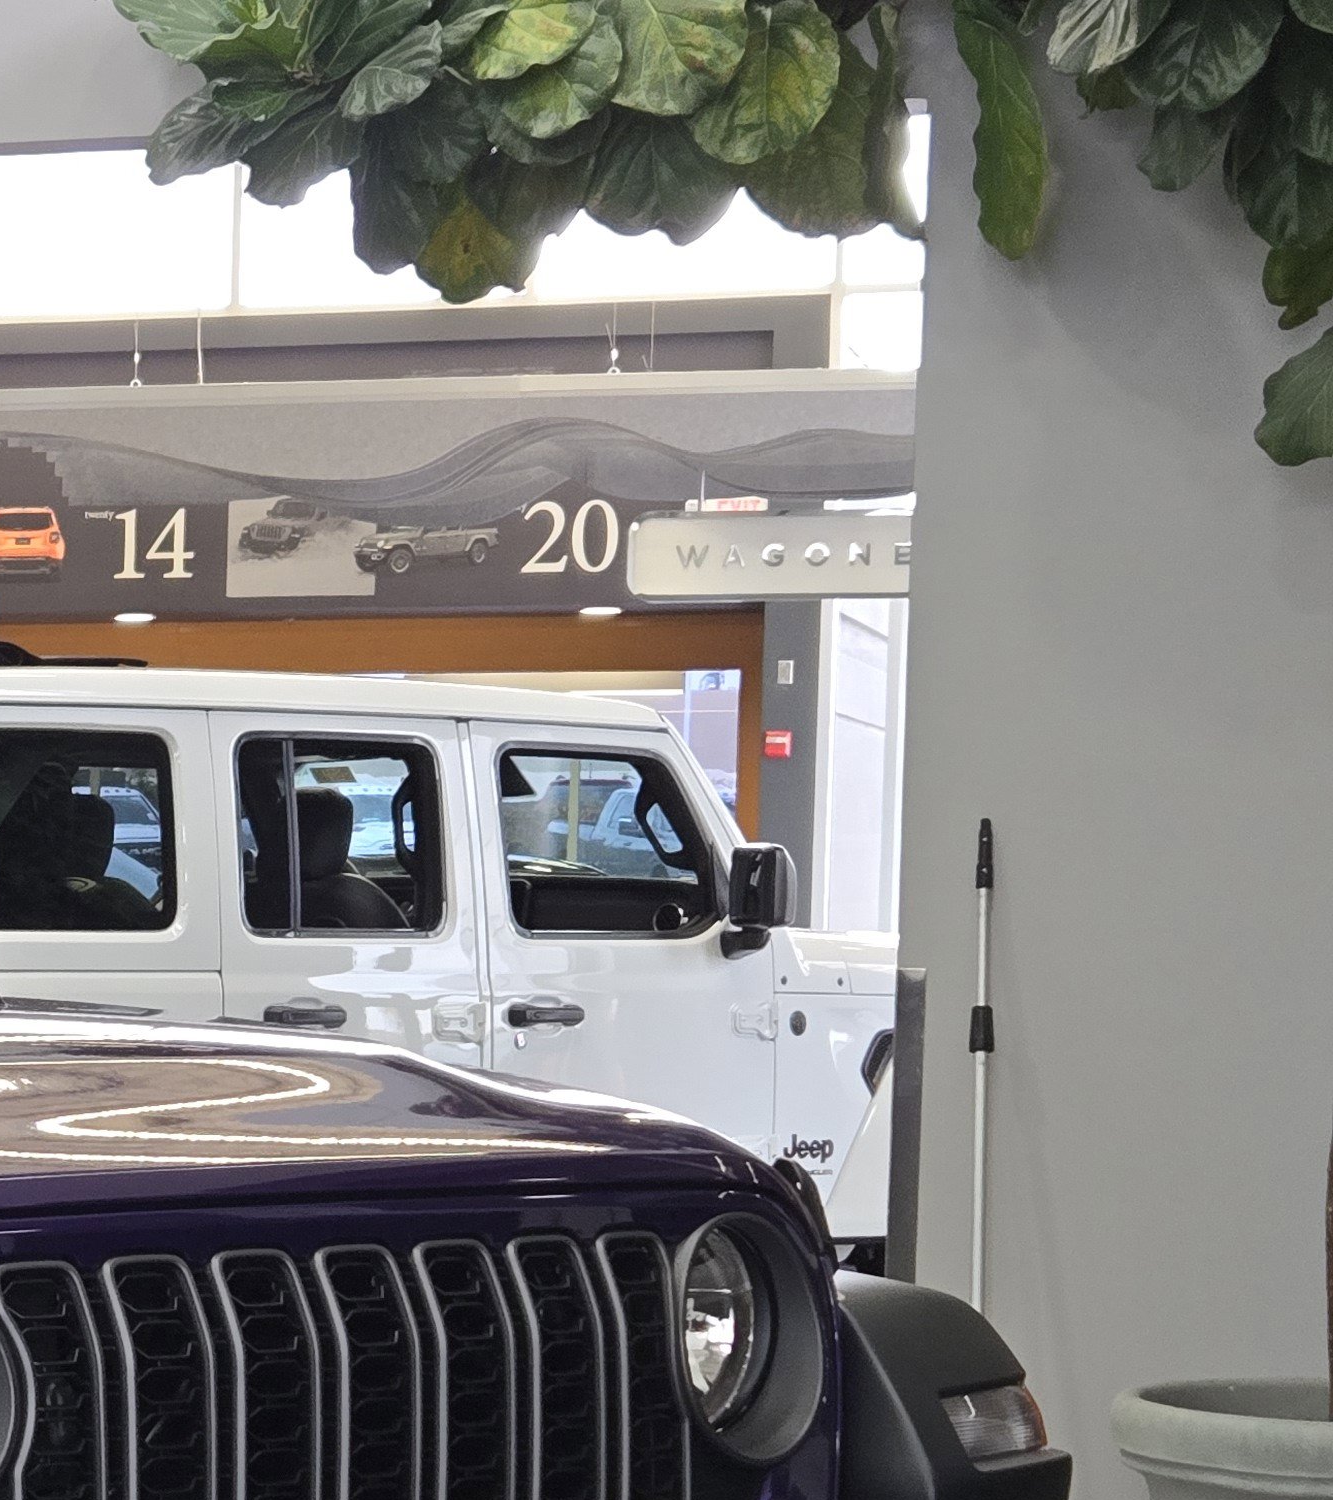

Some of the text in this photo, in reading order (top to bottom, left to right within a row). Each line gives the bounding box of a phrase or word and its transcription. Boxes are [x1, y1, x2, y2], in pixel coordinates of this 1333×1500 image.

[114, 507, 195, 579] 14
[520, 499, 619, 573] 20
[783, 1134, 834, 1163] Jeep
